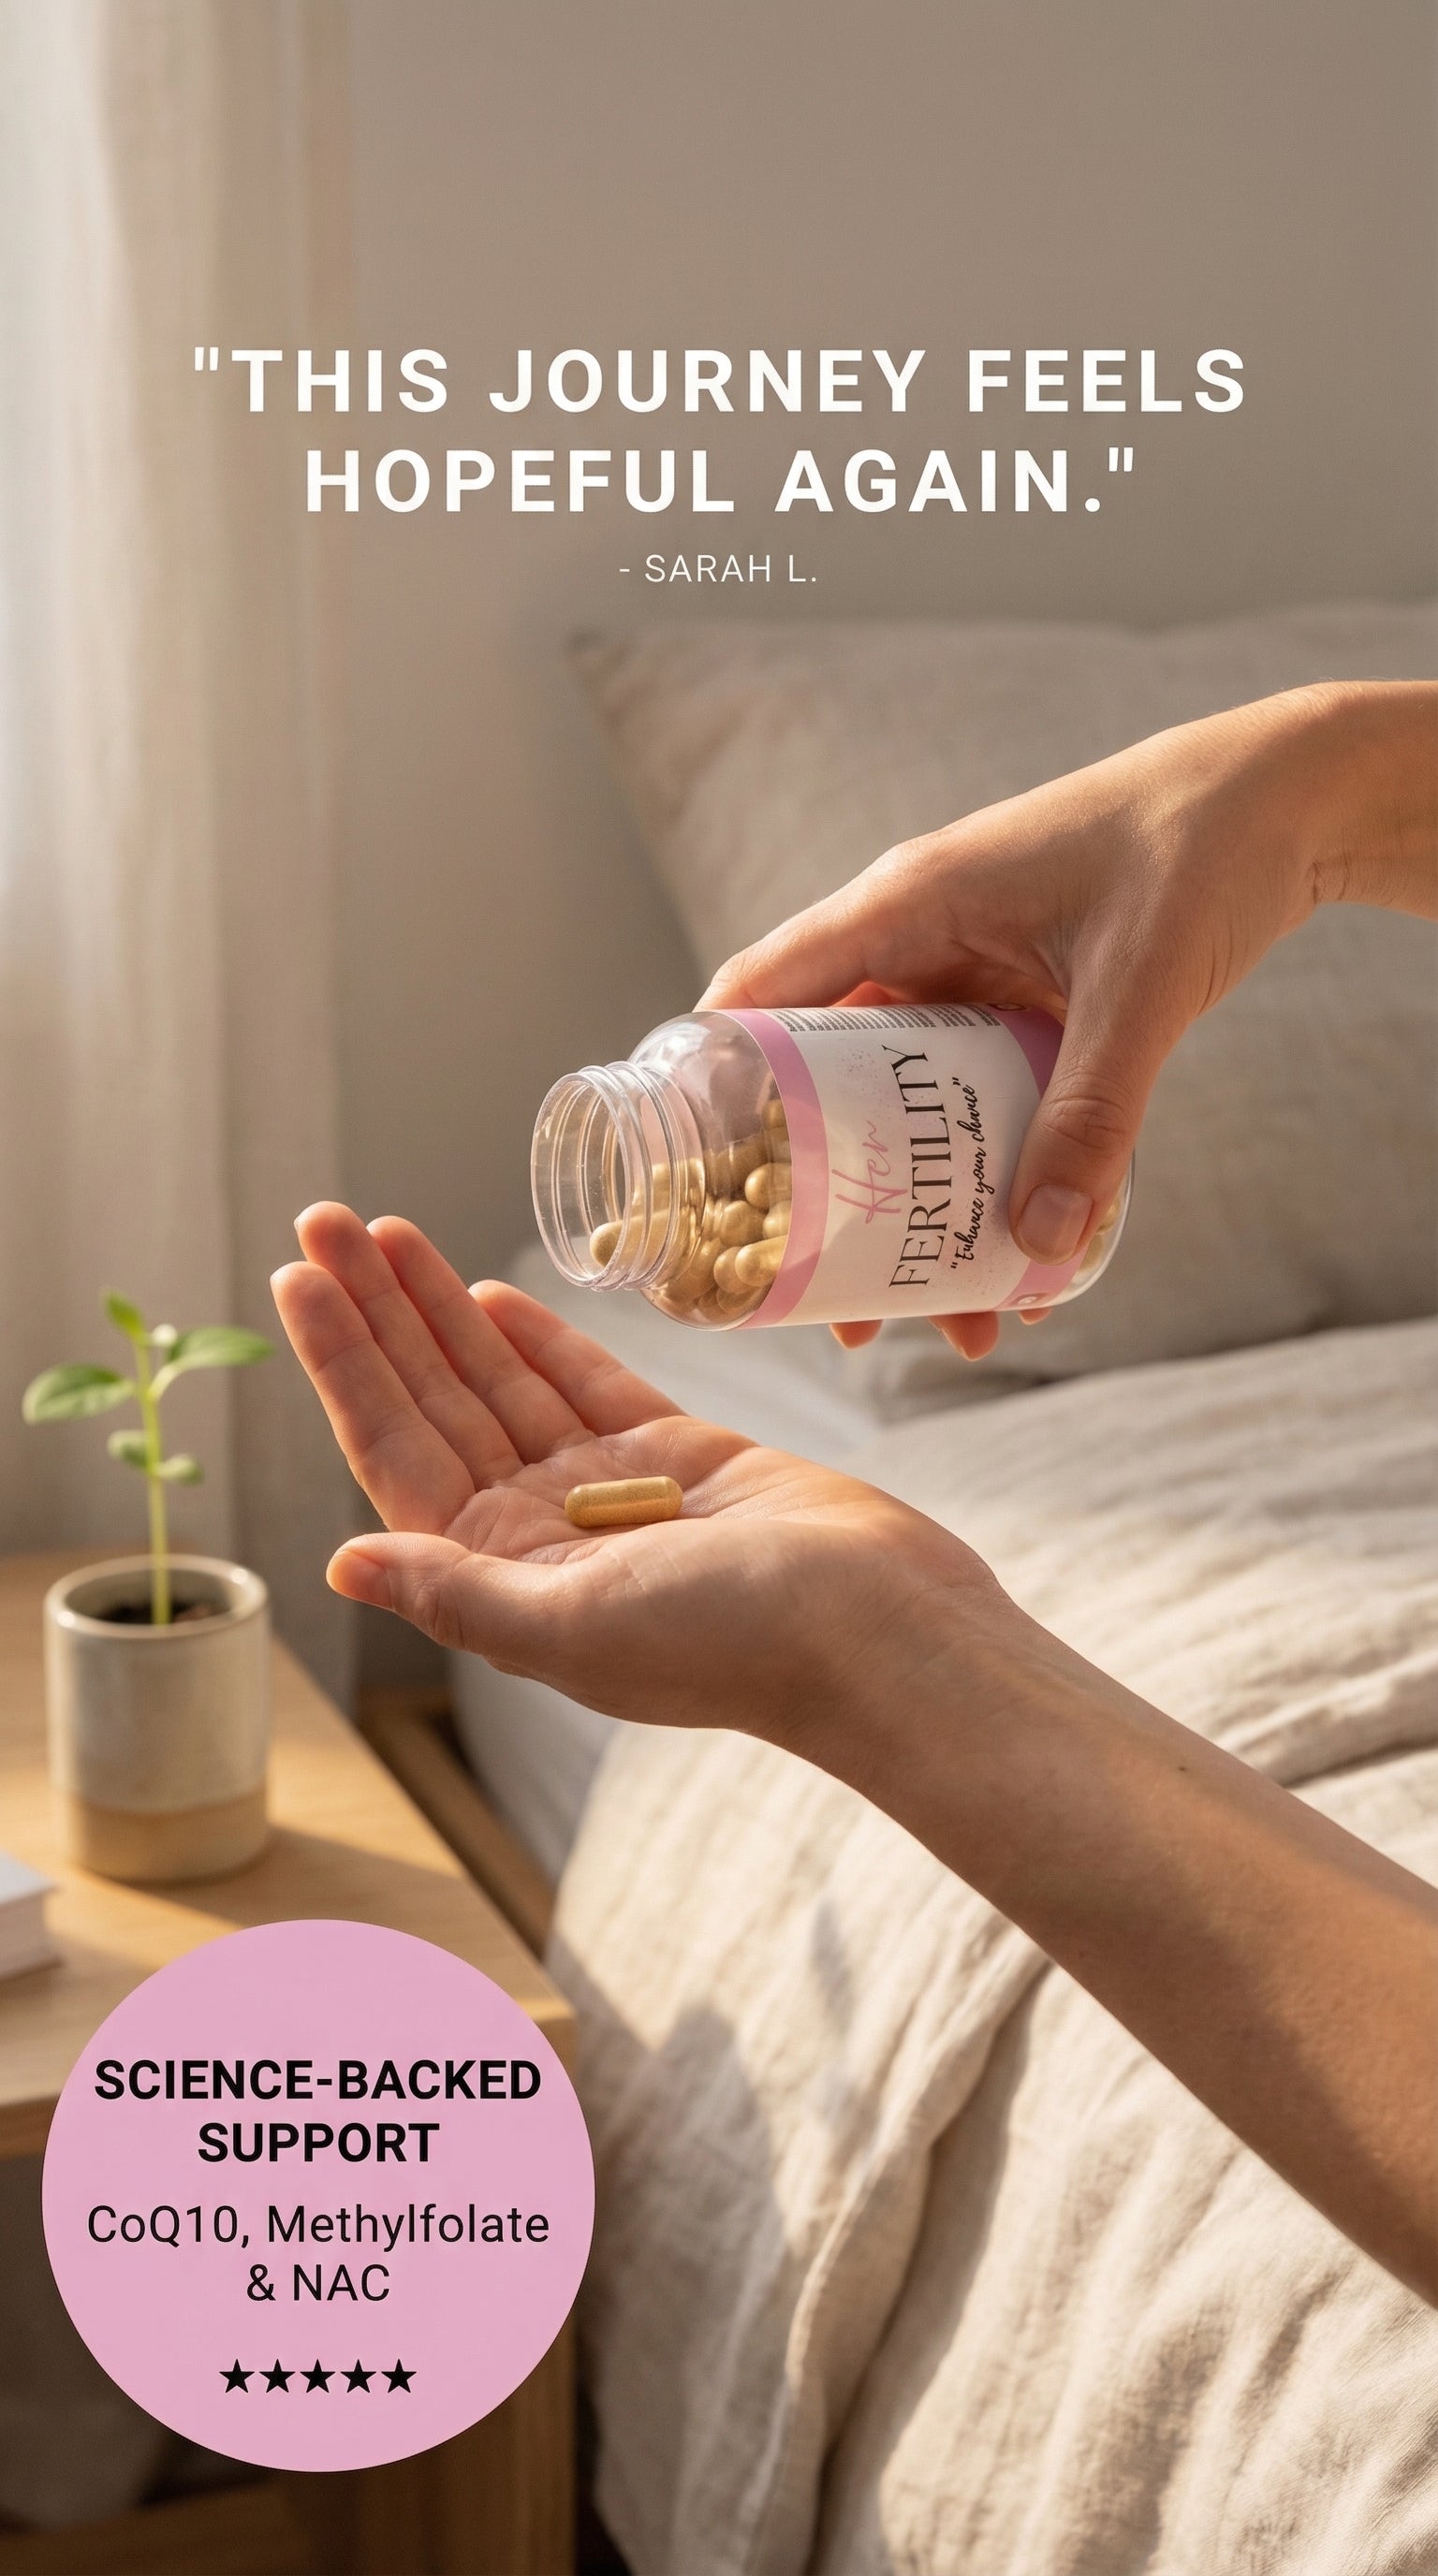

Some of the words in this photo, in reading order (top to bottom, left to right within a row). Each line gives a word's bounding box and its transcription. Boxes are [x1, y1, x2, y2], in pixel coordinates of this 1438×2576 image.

[831, 1120, 908, 1224] Her
[881, 1044, 953, 1288] FERTILITY
[974, 1147, 995, 1195] your
